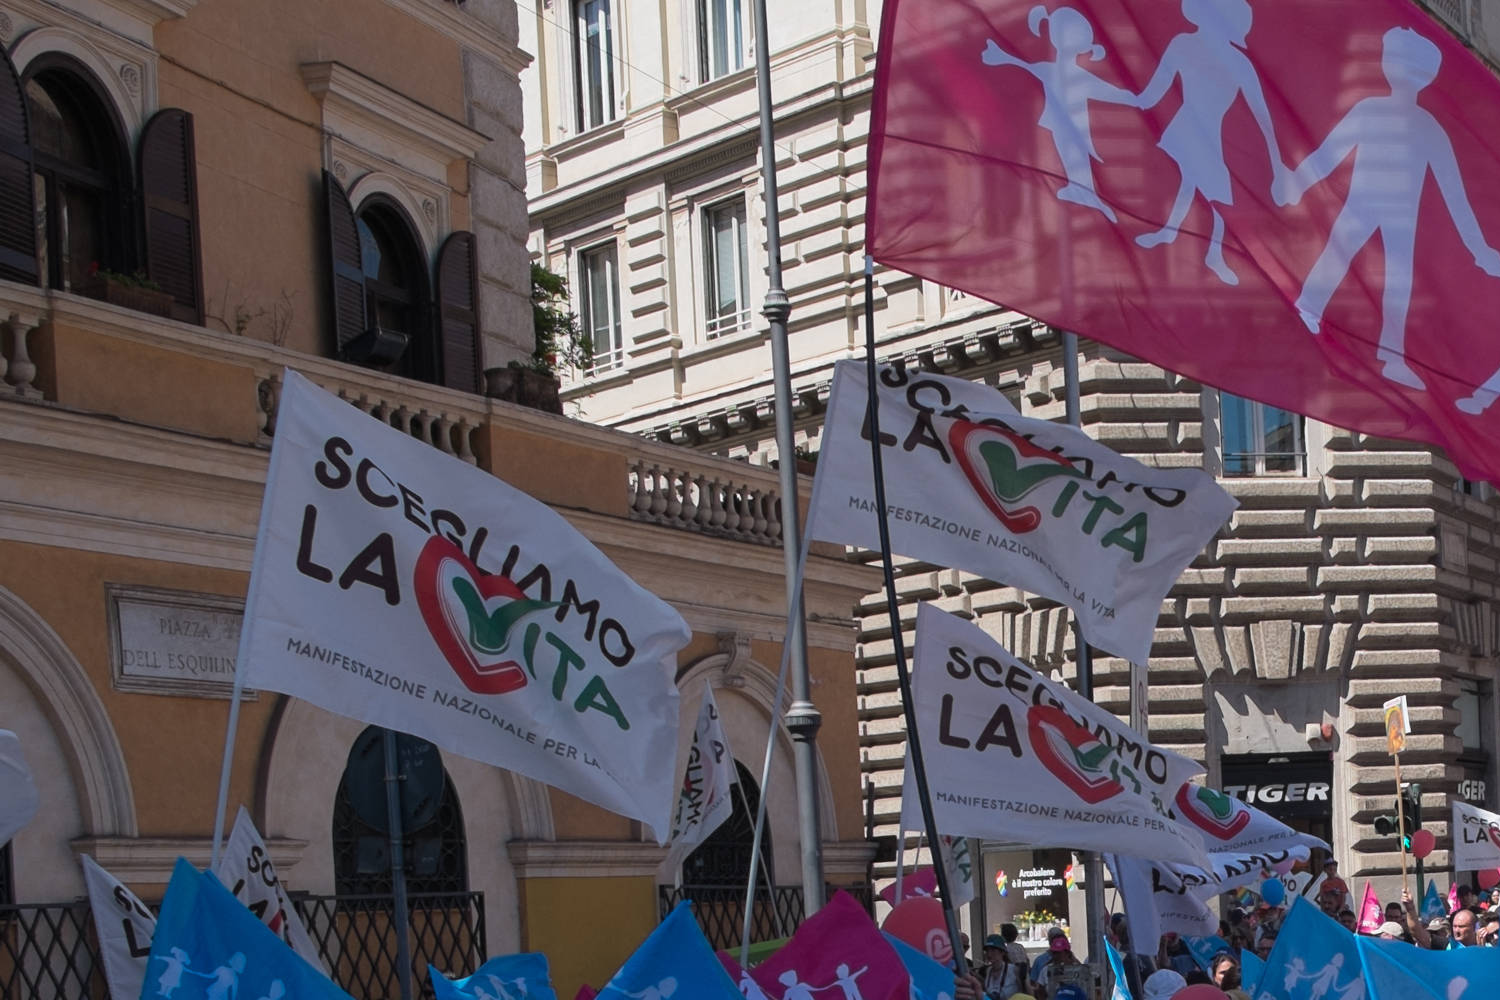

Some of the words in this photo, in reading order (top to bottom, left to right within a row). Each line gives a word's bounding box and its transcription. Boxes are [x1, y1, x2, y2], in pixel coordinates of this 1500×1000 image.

[861, 394, 952, 464] LA
[849, 495, 982, 542] MANFESTAZIONE
[296, 504, 401, 606] LA
[315, 436, 636, 668] SCEGLIAMO
[159, 617, 211, 639] PIAZZA
[168, 652, 236, 675] ESQUILIN
[287, 637, 427, 699] MANIFESTAZIONE
[433, 690, 537, 745] NAZIONALE
[544, 737, 578, 761] PER
[938, 693, 1023, 758] LA
[1222, 782, 1331, 803] TIGER
[936, 791, 1060, 818] MANIFESTAZIONE
[1063, 809, 1140, 827] NAZIONALE
[1144, 818, 1165, 832] PER
[1208, 836, 1266, 853] NAZIONALE
[1463, 828, 1489, 843] LA
[1018, 867, 1056, 878] Arcobaleno
[1022, 878, 1042, 888] nostro
[1043, 876, 1064, 887] colore
[1023, 887, 1052, 899] preferito
